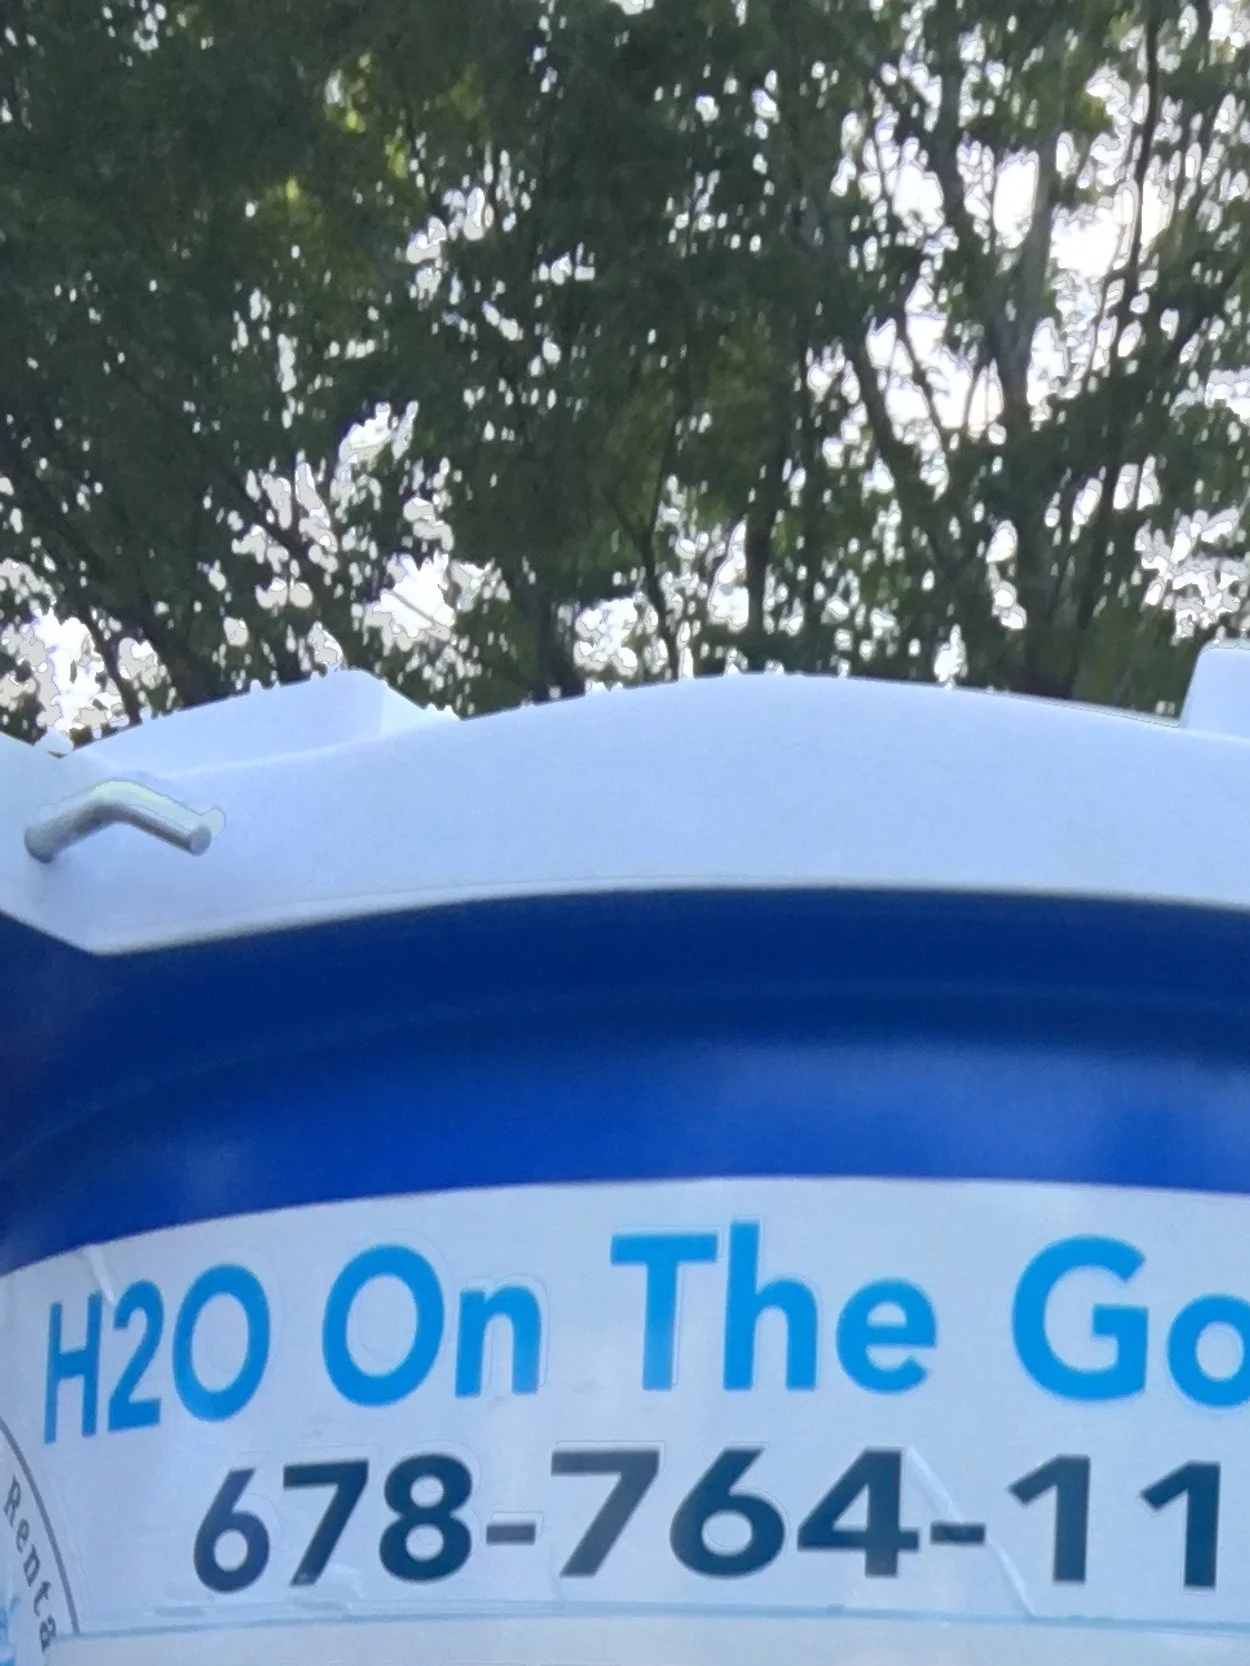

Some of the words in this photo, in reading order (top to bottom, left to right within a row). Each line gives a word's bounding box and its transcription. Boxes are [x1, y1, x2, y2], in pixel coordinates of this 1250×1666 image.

[45, 1265, 270, 1443] H2O
[323, 1246, 541, 1406] On
[611, 1222, 936, 1393] The
[3, 1474, 57, 1662] Renta
